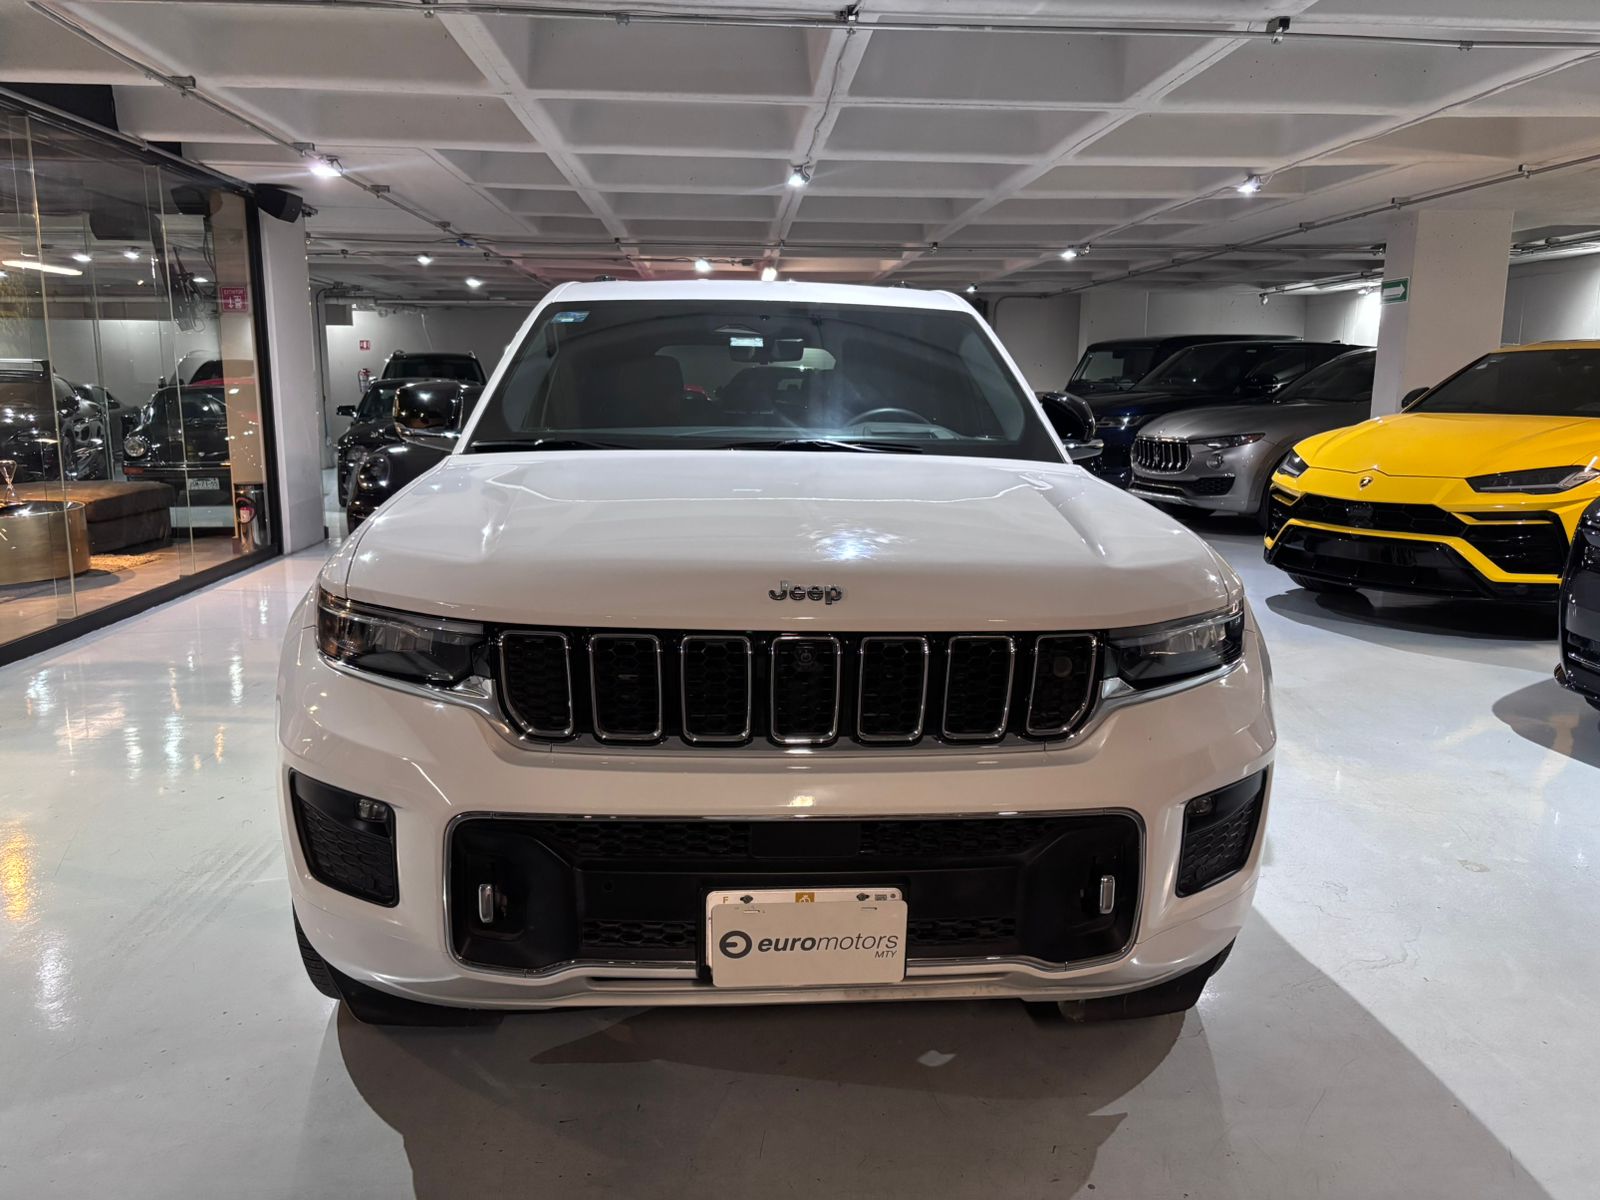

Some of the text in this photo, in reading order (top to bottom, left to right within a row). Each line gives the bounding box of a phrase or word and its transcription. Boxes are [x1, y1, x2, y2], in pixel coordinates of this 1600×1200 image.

[768, 580, 842, 605] Jeep
[757, 932, 899, 953] euromotors
[874, 950, 898, 959] MTY
